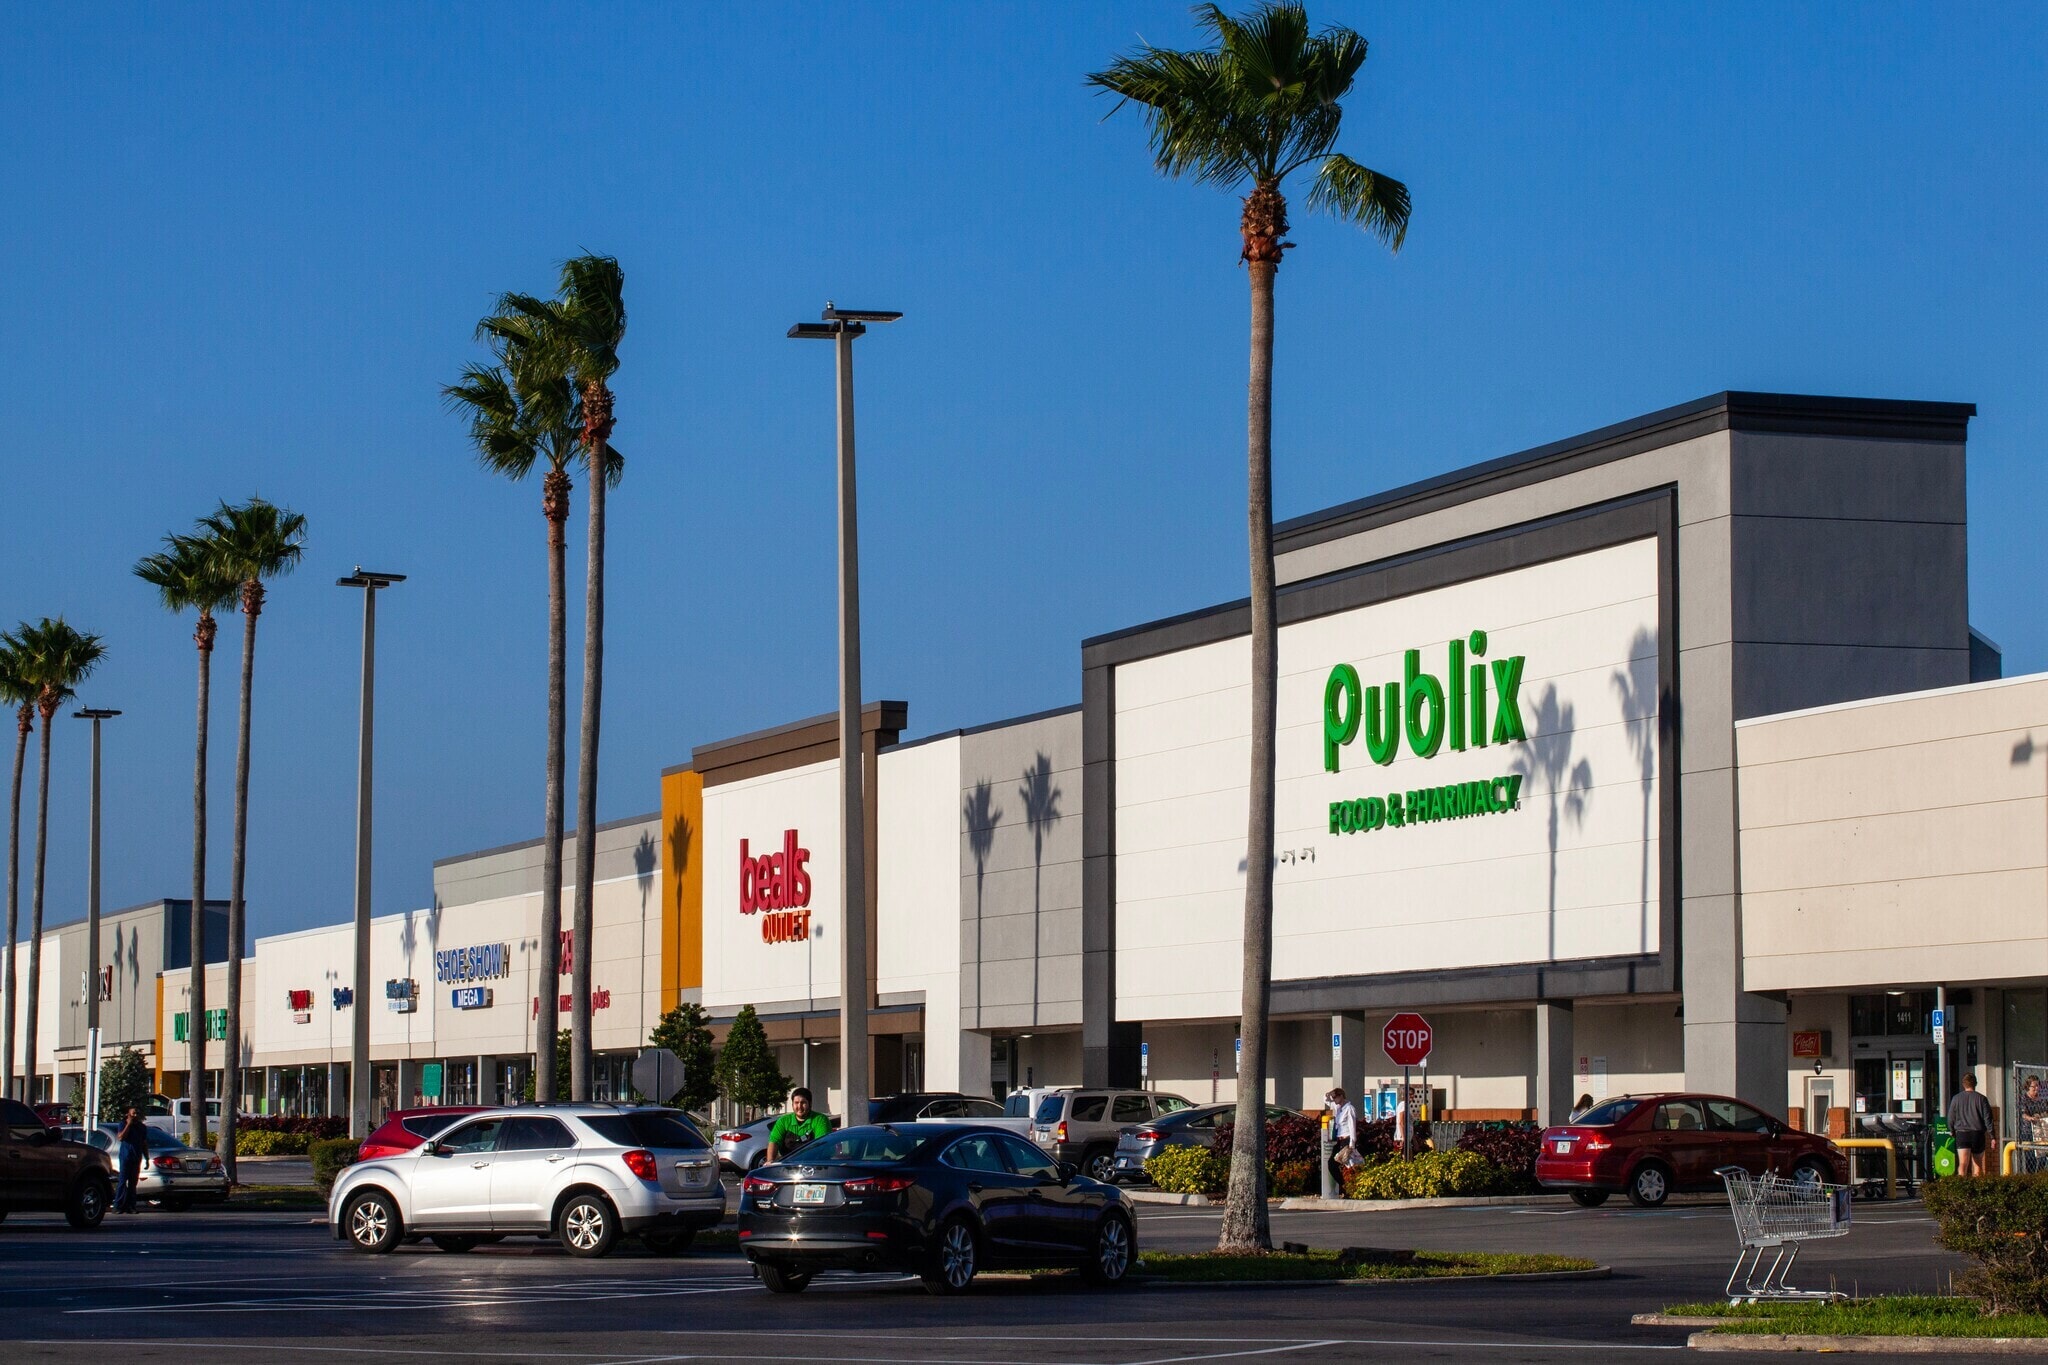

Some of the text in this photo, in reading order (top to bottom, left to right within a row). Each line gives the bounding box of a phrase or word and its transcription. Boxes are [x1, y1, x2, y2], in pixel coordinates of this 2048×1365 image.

[1324, 629, 1526, 773] Publix
[1329, 775, 1523, 835] FOOD & PHARMACY
[762, 910, 811, 943] OUTLET
[436, 943, 504, 982] SHOE SHOW
[457, 989, 479, 1006] MEGA
[592, 985, 610, 1016] plus
[1896, 1011, 1911, 1023] 1411
[1386, 1029, 1429, 1049] STOP
